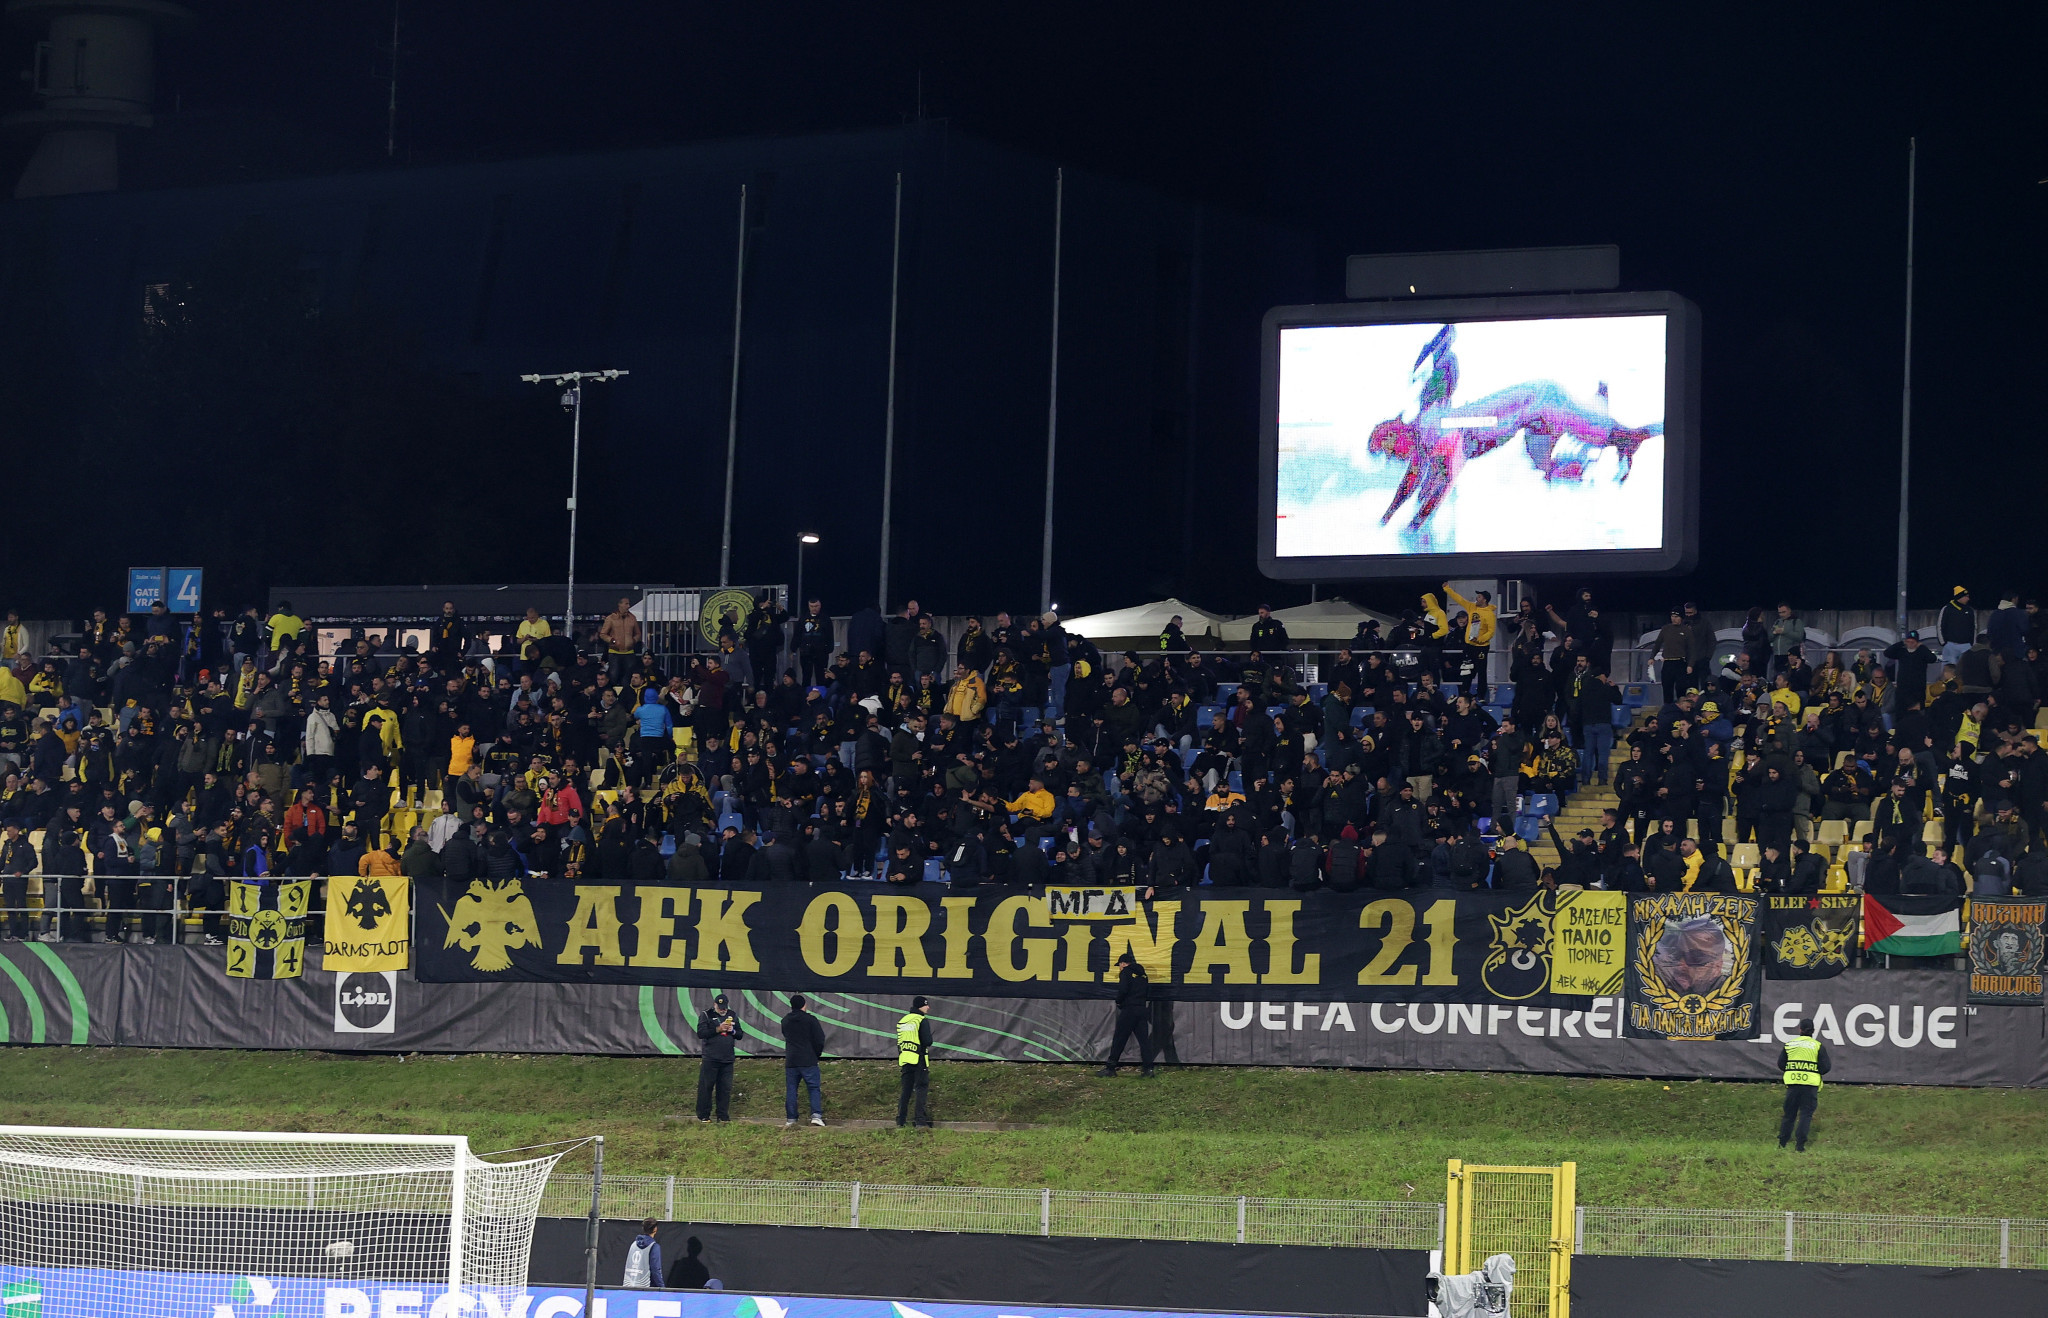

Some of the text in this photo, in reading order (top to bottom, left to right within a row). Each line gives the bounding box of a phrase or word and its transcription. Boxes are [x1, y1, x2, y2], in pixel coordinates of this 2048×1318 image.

[135, 588, 159, 596] GATE
[177, 575, 198, 606] 4
[1770, 896, 1808, 909] ELEF
[556, 886, 1460, 986] AEK ORIGINAL 21
[1562, 928, 1612, 946] ΠΑΛΙΟ
[324, 940, 409, 956] DARMSTADT
[1568, 948, 1614, 964] ΠΟΡΝΕΣ
[1972, 975, 2042, 994] HARDCORE
[1220, 1001, 1356, 1032] UEFA
[1370, 997, 1624, 1039] CONFERE
[1790, 1073, 1808, 1081] 030
